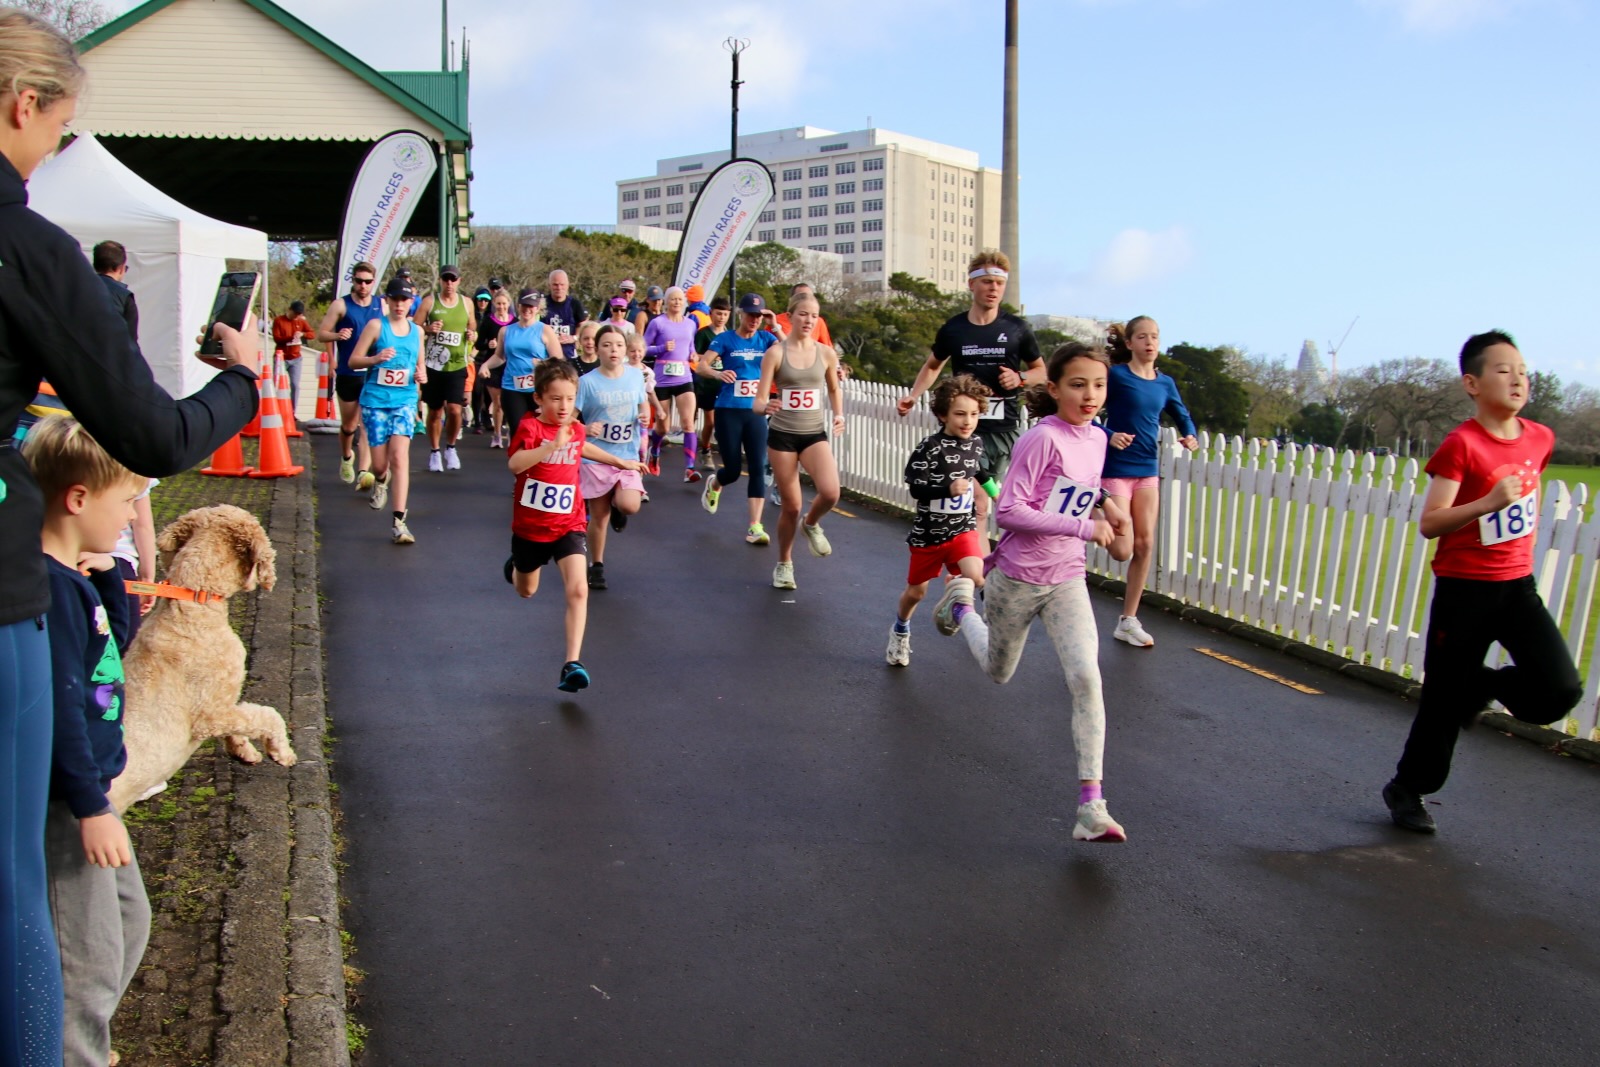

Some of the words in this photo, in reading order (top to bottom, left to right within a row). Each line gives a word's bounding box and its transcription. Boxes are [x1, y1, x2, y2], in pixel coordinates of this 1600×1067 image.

[353, 210, 384, 261] CHINMOY
[377, 171, 404, 211] RACES
[689, 231, 721, 278] CHINMOY
[715, 196, 743, 232] RACES
[437, 331, 460, 345] 648
[961, 347, 1006, 356] NORSEMAN
[665, 363, 684, 374] 213
[384, 370, 405, 385] 52
[517, 374, 535, 388] 73
[740, 381, 760, 396] 53
[789, 391, 814, 409] 55
[602, 423, 632, 441] 185
[527, 482, 573, 510] 186
